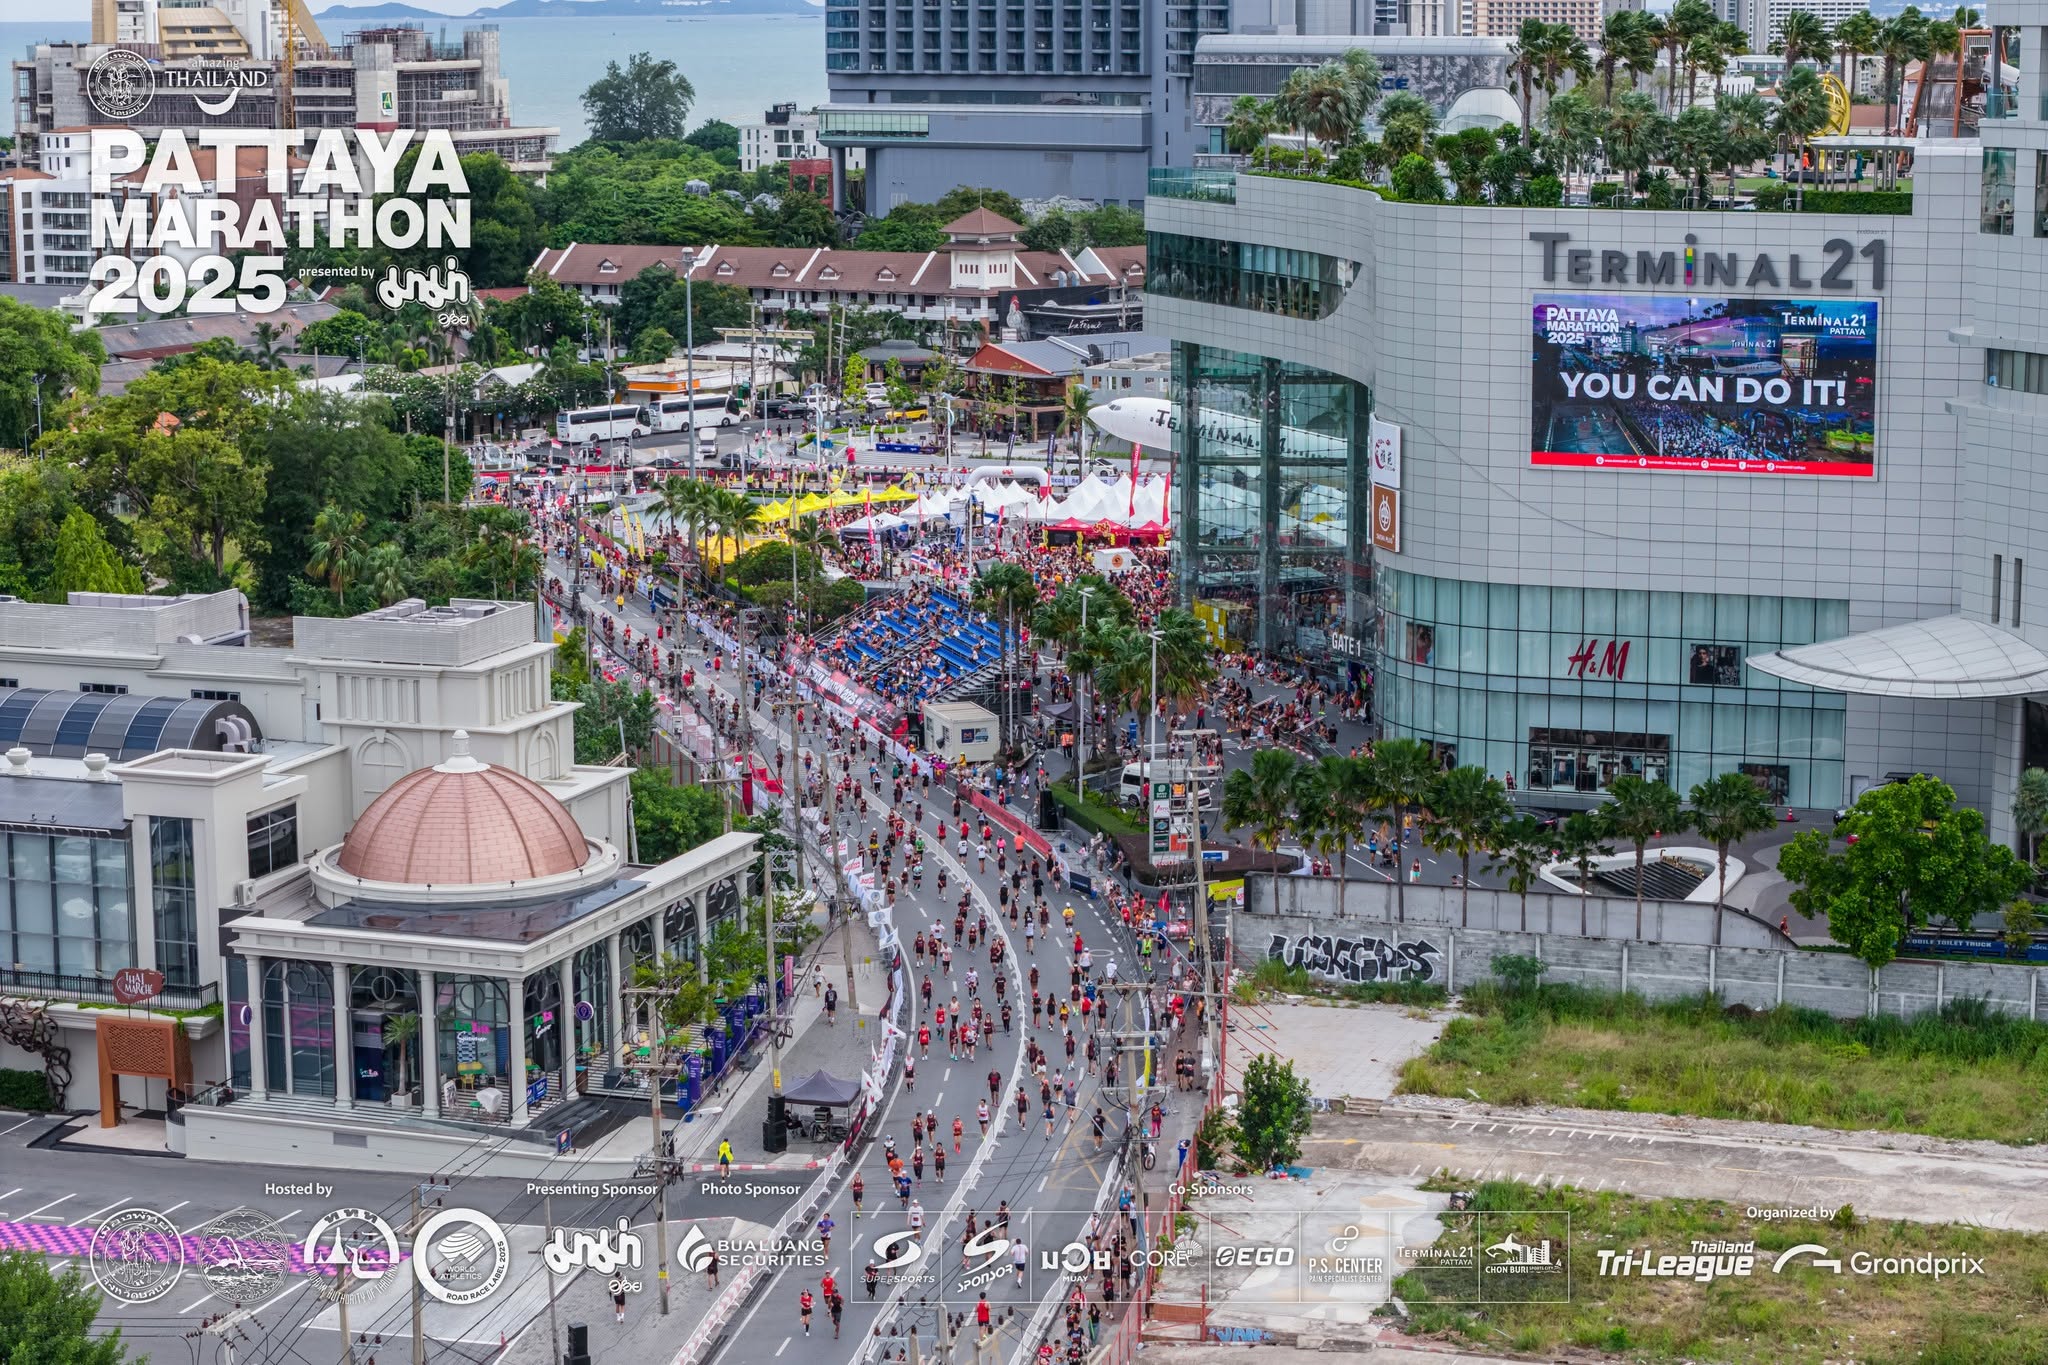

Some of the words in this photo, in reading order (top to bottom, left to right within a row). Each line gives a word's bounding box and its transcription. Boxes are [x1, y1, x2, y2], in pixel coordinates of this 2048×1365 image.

[1546, 307, 1619, 322] PATTAYA
[1546, 321, 1620, 333] MARATHON
[1830, 327, 1866, 335] PATTAYA
[1548, 332, 1585, 344] 2025
[1559, 371, 1636, 399] YOU
[1647, 374, 1724, 403] CAN
[1736, 377, 1791, 405] DO
[1802, 379, 1846, 406] IT!
[1332, 631, 1355, 655] GATE
[1356, 640, 1361, 656] 1
[1567, 639, 1631, 681] H&M
[125, 971, 145, 986] THAI
